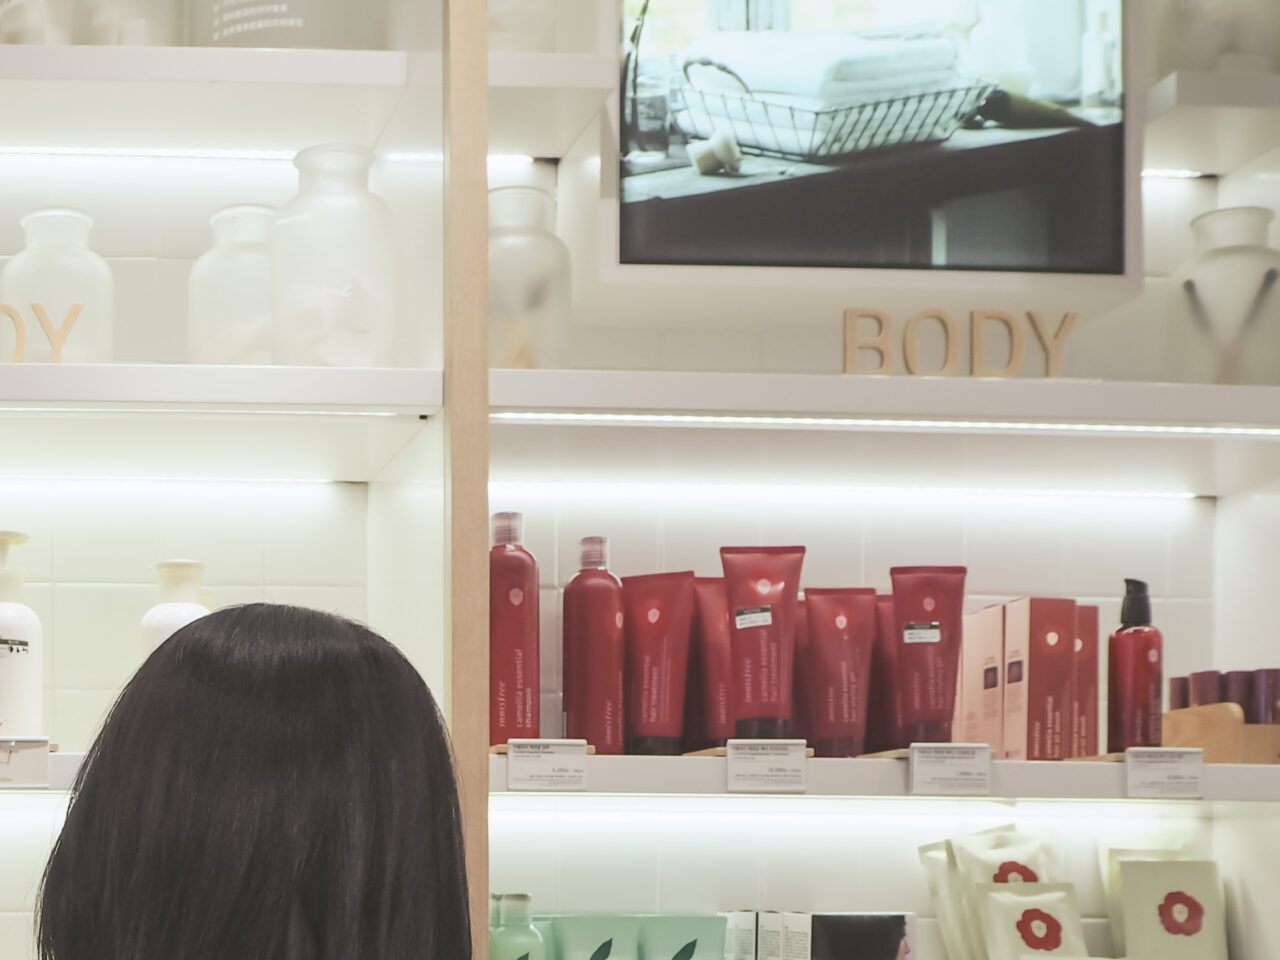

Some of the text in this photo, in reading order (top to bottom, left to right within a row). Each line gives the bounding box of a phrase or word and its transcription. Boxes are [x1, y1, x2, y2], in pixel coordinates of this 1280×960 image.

[842, 308, 1078, 377] BODY
[514, 648, 524, 689] essential
[744, 656, 753, 703] innisfree
[498, 679, 507, 728] innisfree
[525, 687, 533, 728] shampoo
